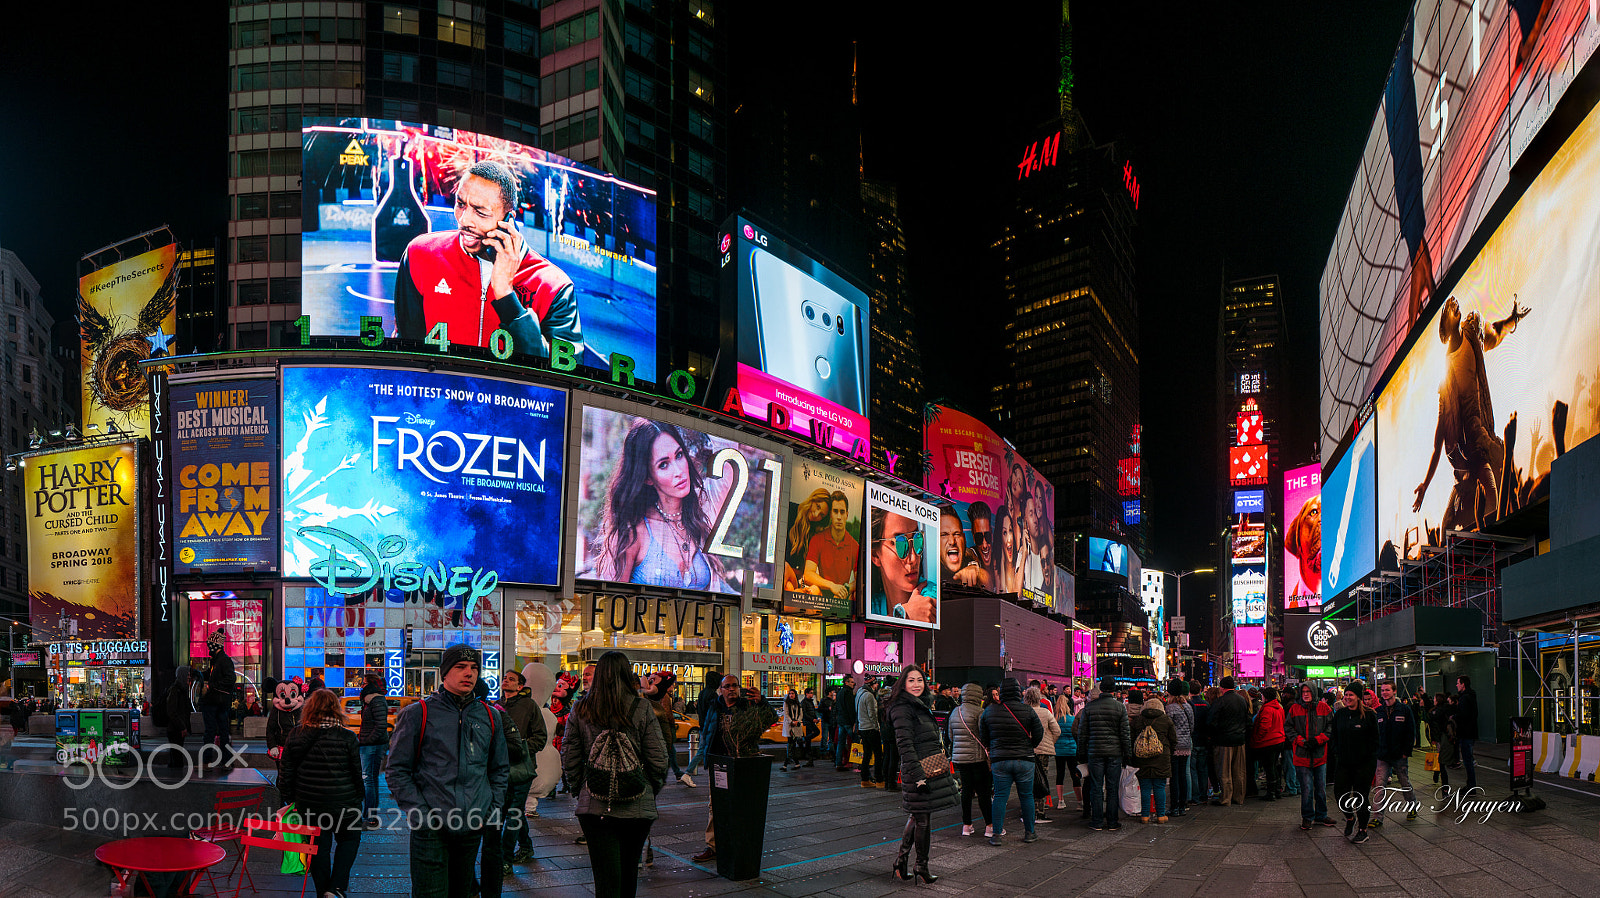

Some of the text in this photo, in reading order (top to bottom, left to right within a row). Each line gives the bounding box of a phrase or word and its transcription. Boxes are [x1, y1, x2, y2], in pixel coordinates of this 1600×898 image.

[340, 154, 369, 166] PEAK
[1018, 131, 1060, 181] H&M
[755, 230, 768, 247] LG
[594, 245, 628, 263] Howard
[721, 252, 731, 268] LG
[90, 263, 164, 294] #KeepTheSecrets
[196, 389, 248, 409] WINNER!
[397, 385, 441, 399] HOTTEST
[444, 388, 474, 401] SNOW
[477, 391, 492, 404] ON
[775, 389, 852, 428] Introducing the LG V30
[1241, 404, 1258, 412] 2018
[177, 406, 268, 429] BEST MUSICAL
[403, 412, 435, 429] Disney
[177, 424, 269, 440] ALL ACROSS NORTH AMERICA
[940, 427, 952, 435] THE
[954, 429, 975, 438] ESCAPE
[370, 415, 546, 484] FROZEN
[953, 450, 993, 473] JERSEY
[38, 456, 123, 490] HARRY
[179, 462, 269, 488] COME
[812, 469, 856, 490] U.S. POLO ASSN.
[968, 469, 999, 490] SHORE
[1230, 477, 1268, 486] TOSHIBA
[461, 476, 546, 493] THE BROADWAY MUSICAL
[958, 486, 979, 495] FAMILY
[1286, 476, 1308, 490] THE
[34, 483, 129, 518] POTTER
[705, 447, 782, 563] 21
[870, 488, 938, 522] MICHAEL KORS
[1242, 499, 1262, 507] TDK
[44, 513, 119, 530] CURSED CHILD
[66, 511, 80, 519] AND
[179, 511, 270, 538] AWAY
[52, 548, 111, 560] BROADWAY
[50, 557, 113, 569] SPRING 2018
[590, 591, 725, 638] FOREVER
[91, 641, 148, 653] LUGGAGE
[95, 652, 108, 660] NY
[752, 654, 817, 667] U.S. POLO ASSN.
[683, 664, 694, 678] 21
[864, 662, 892, 674] sunglass
